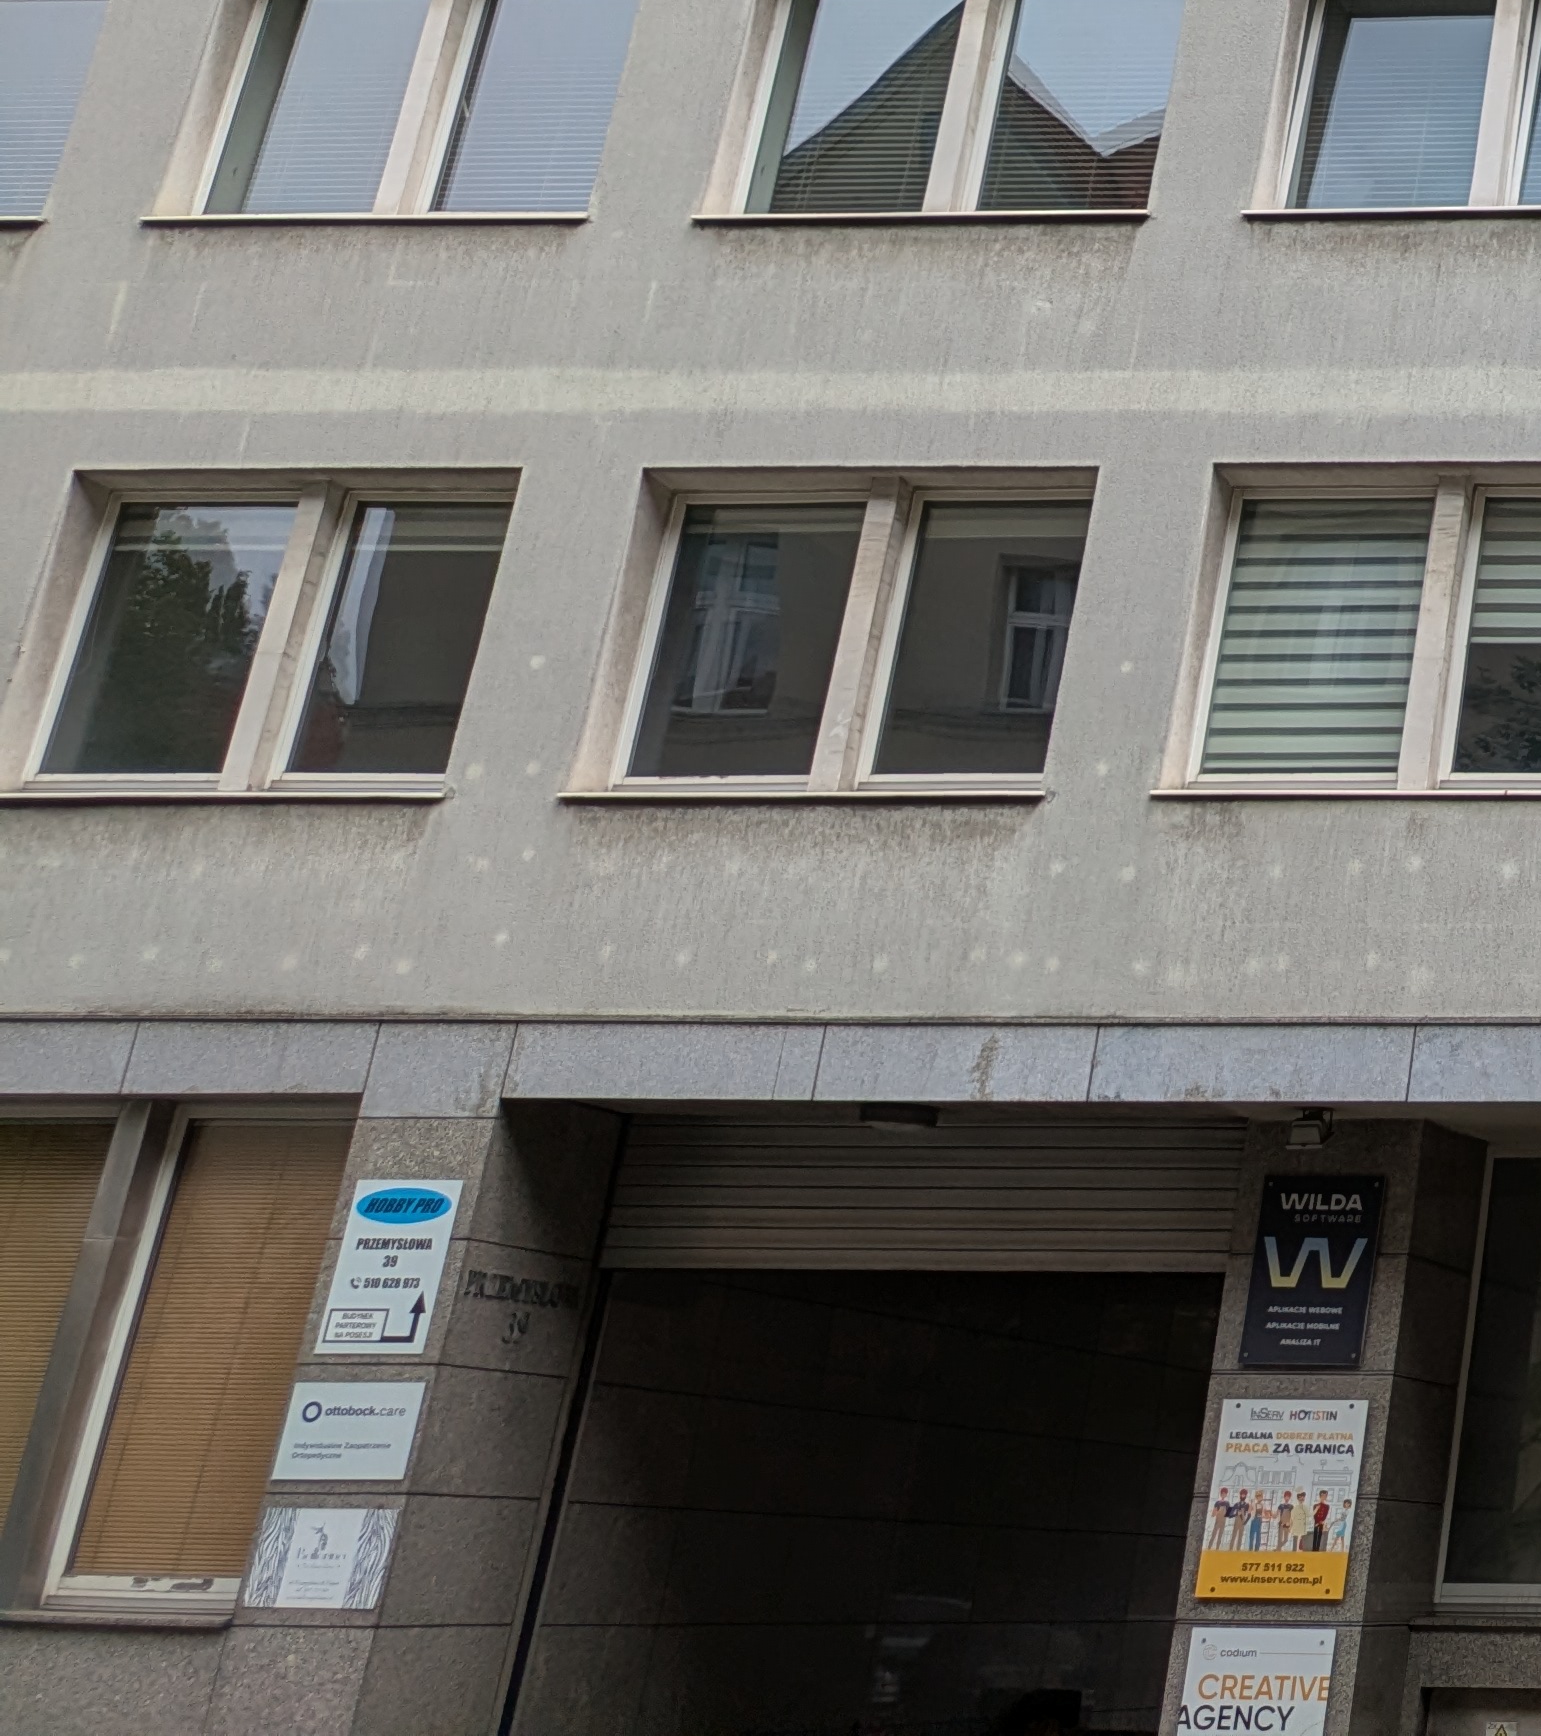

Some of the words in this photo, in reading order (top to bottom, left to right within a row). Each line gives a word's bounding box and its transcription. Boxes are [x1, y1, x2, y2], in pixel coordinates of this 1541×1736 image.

[364, 1197, 414, 1214] HOBBY
[412, 1197, 445, 1214] PRO
[1280, 1192, 1363, 1211] WILDA
[1294, 1214, 1362, 1223] SOFTWARE
[356, 1237, 433, 1251] PRZEMYSŁOWA
[382, 1255, 399, 1268] 39
[363, 1277, 381, 1289] 510
[382, 1277, 401, 1289] 628
[402, 1277, 421, 1289] 973
[1229, 1431, 1273, 1440] LEGALNA
[1275, 1432, 1314, 1440] DOBRZE
[1225, 1442, 1269, 1454] PRACA
[1272, 1443, 1290, 1454] ZA
[1294, 1443, 1354, 1457] GRANICĄ
[1242, 1563, 1260, 1572] 577
[1263, 1563, 1282, 1572] 511
[1286, 1563, 1305, 1573] 922
[1220, 1575, 1323, 1586] www.inserv.com.pl
[1220, 1648, 1258, 1658] codium
[1198, 1673, 1331, 1702] CREATIVE
[1177, 1704, 1295, 1732] AGENCY
